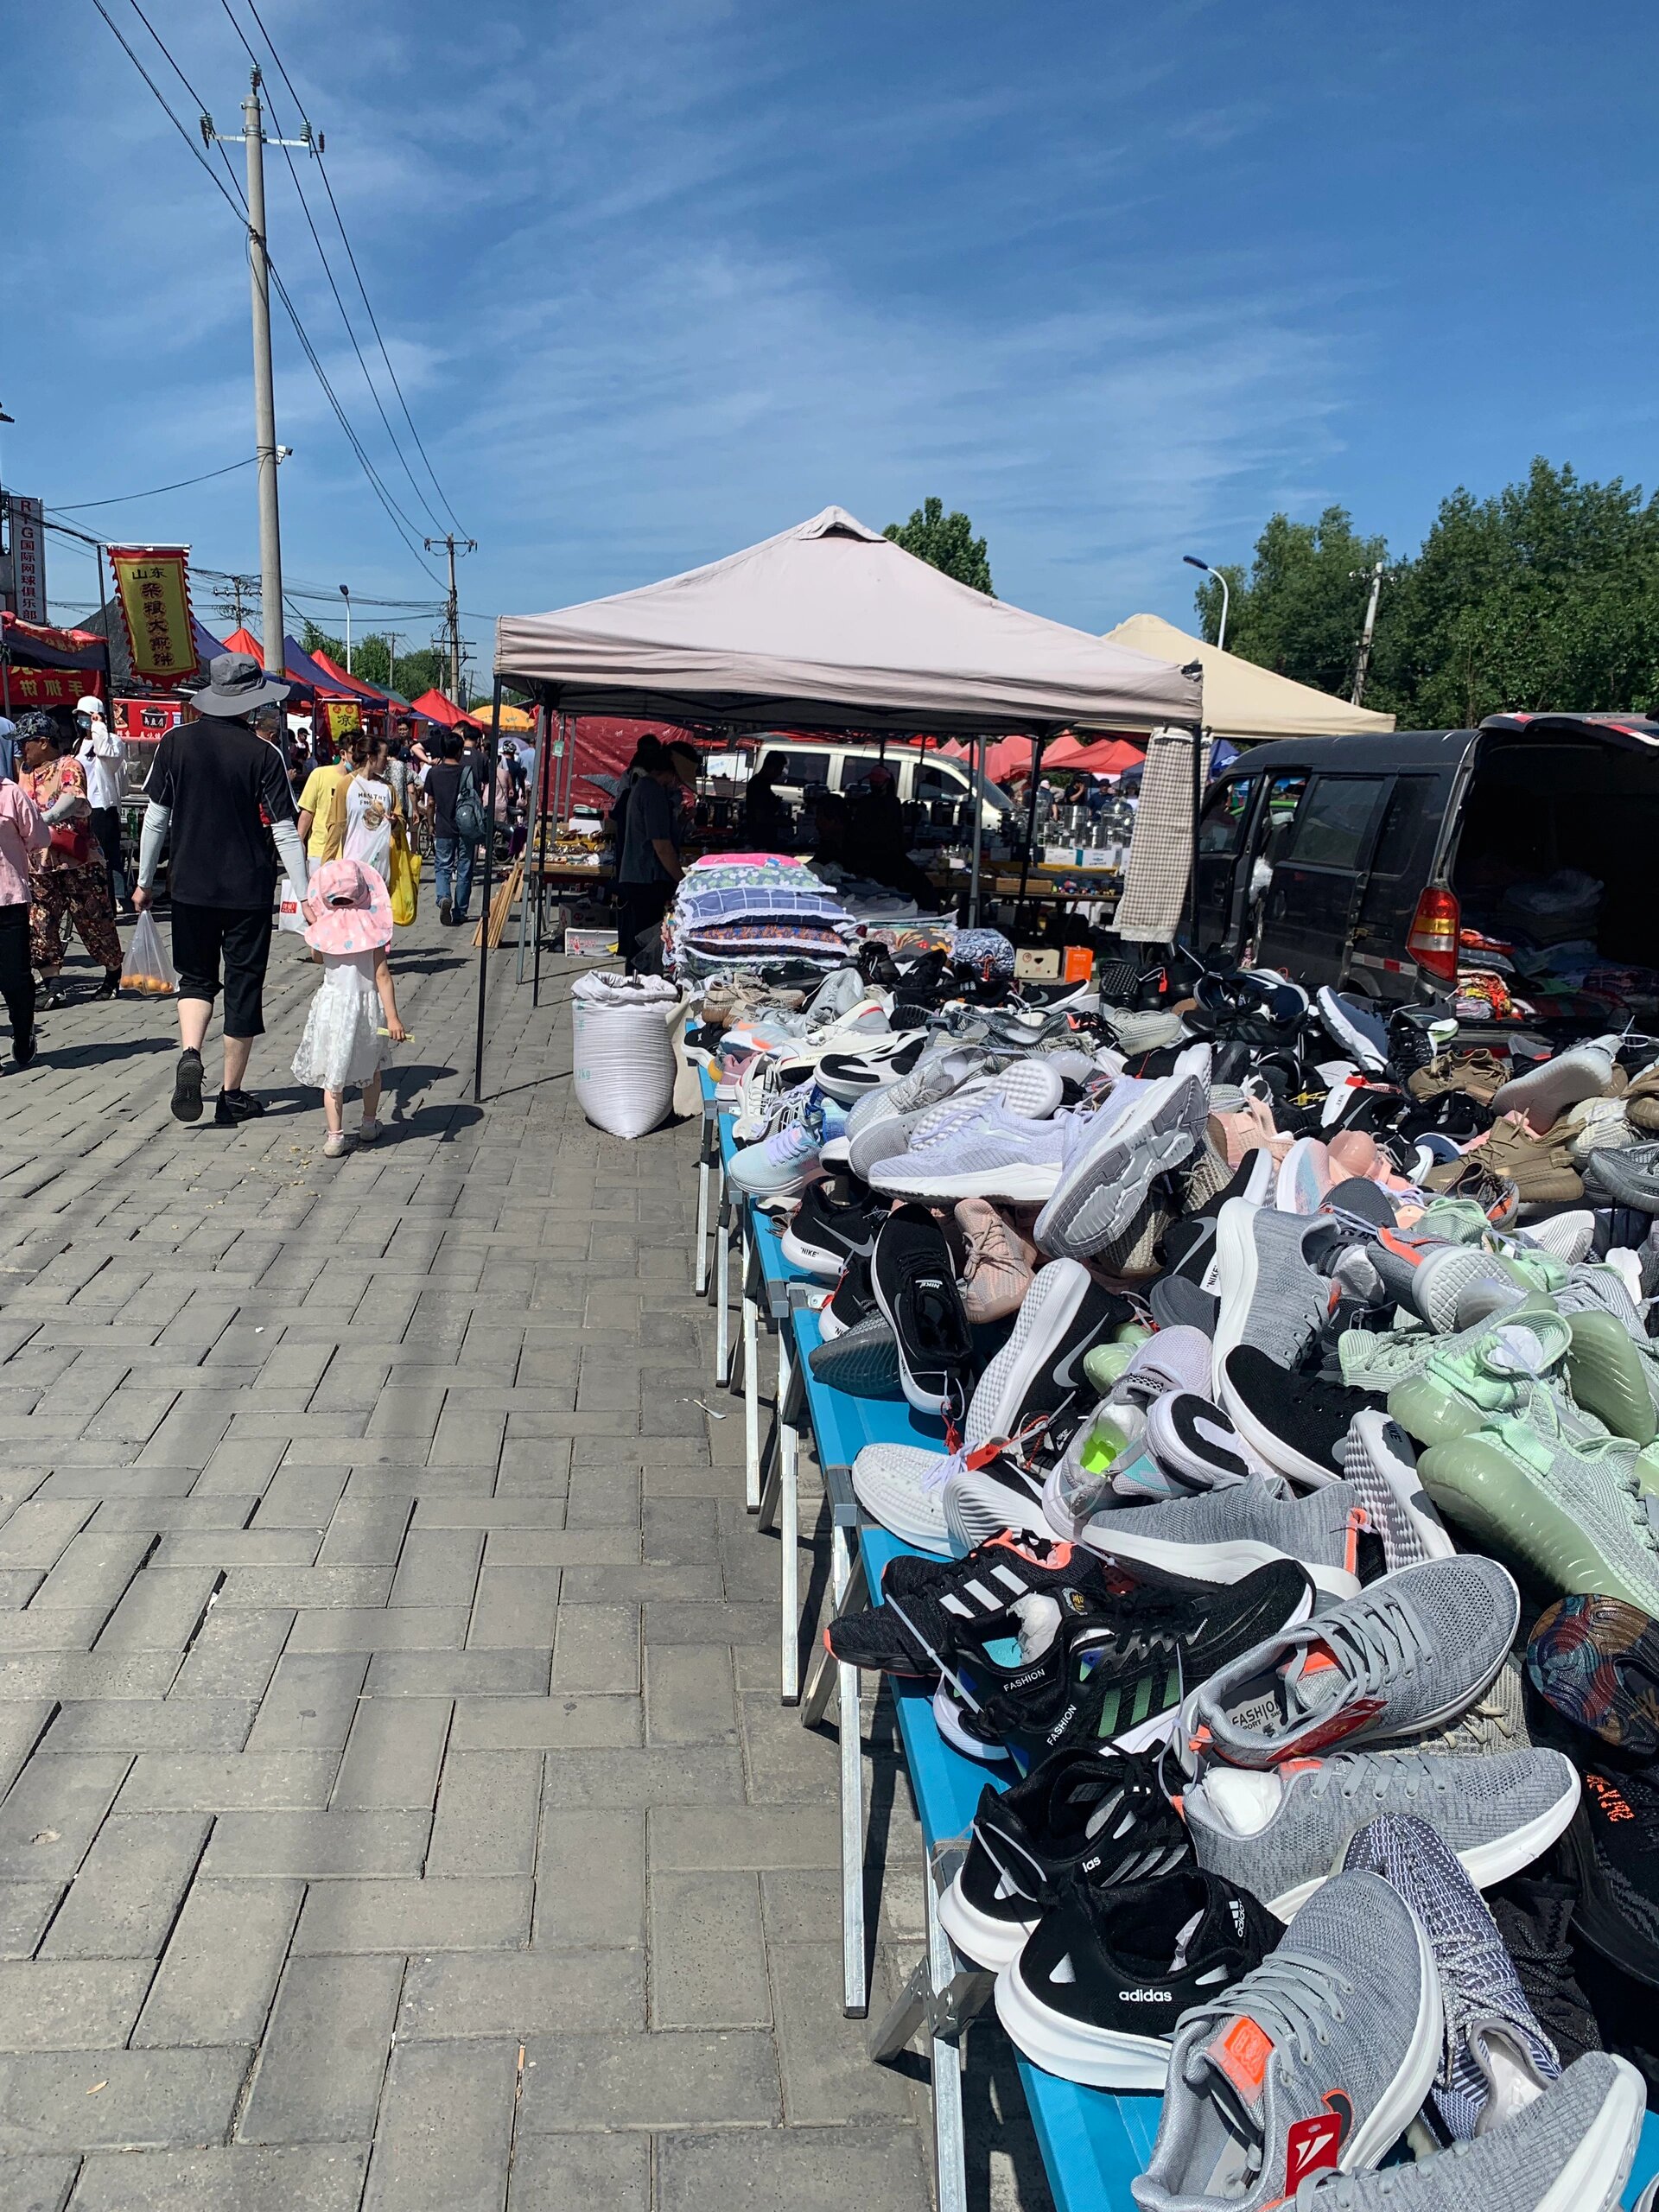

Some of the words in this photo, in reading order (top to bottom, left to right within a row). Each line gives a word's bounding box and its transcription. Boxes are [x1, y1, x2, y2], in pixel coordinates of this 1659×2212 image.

[132, 567, 168, 580] 山东
[800, 1247, 820, 1258] "NIKE"
[1003, 1669, 1046, 1692] FASHION
[1046, 1704, 1077, 1746] FASHION
[1118, 1988, 1173, 2003] adidas
